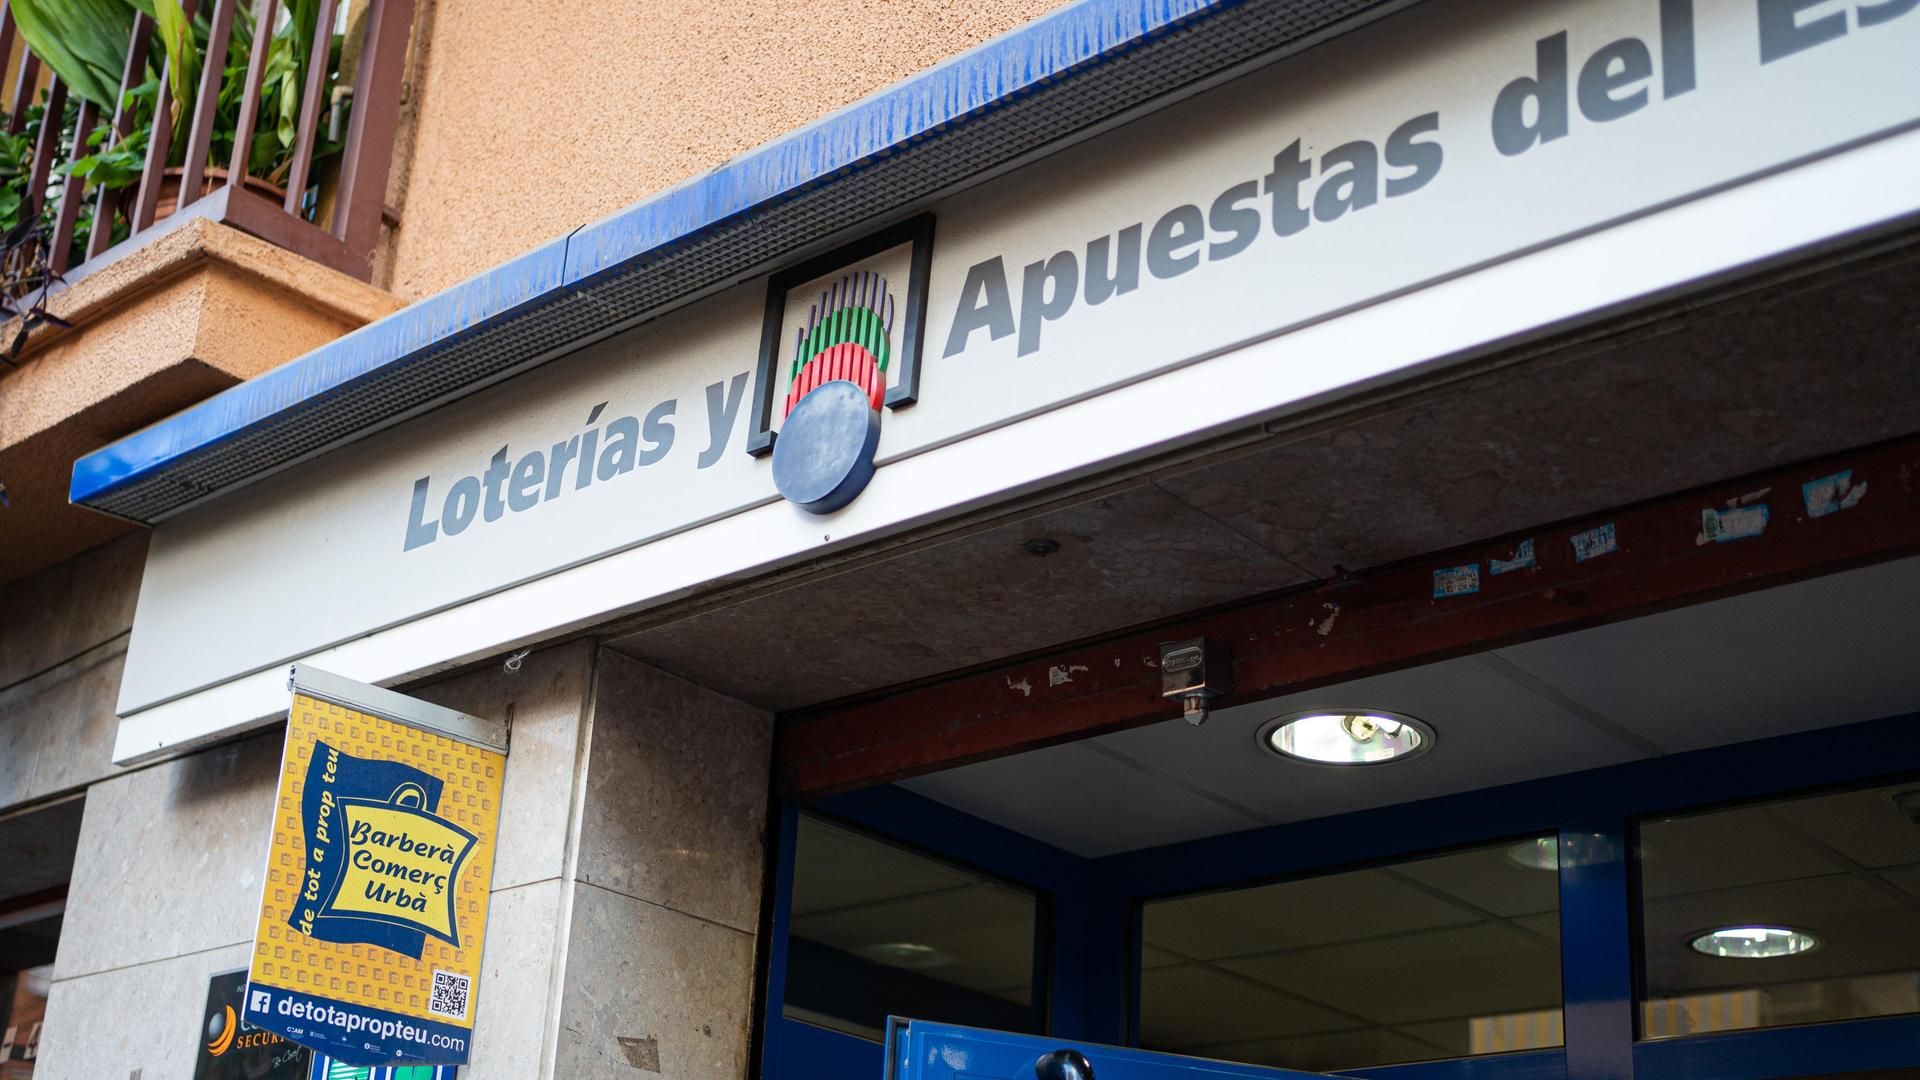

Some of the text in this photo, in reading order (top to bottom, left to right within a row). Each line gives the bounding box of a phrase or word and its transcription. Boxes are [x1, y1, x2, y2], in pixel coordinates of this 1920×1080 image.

[403, 399, 678, 552] Loterías
[697, 371, 750, 469] y
[942, 111, 1444, 359] Apuestas
[1491, 0, 1696, 157] del
[299, 748, 339, 936] de tot a prop teu
[350, 819, 455, 864] Barberà
[353, 849, 447, 895] Comerç
[364, 880, 428, 912] Urbà
[277, 995, 464, 1052] detotapropteu.com
